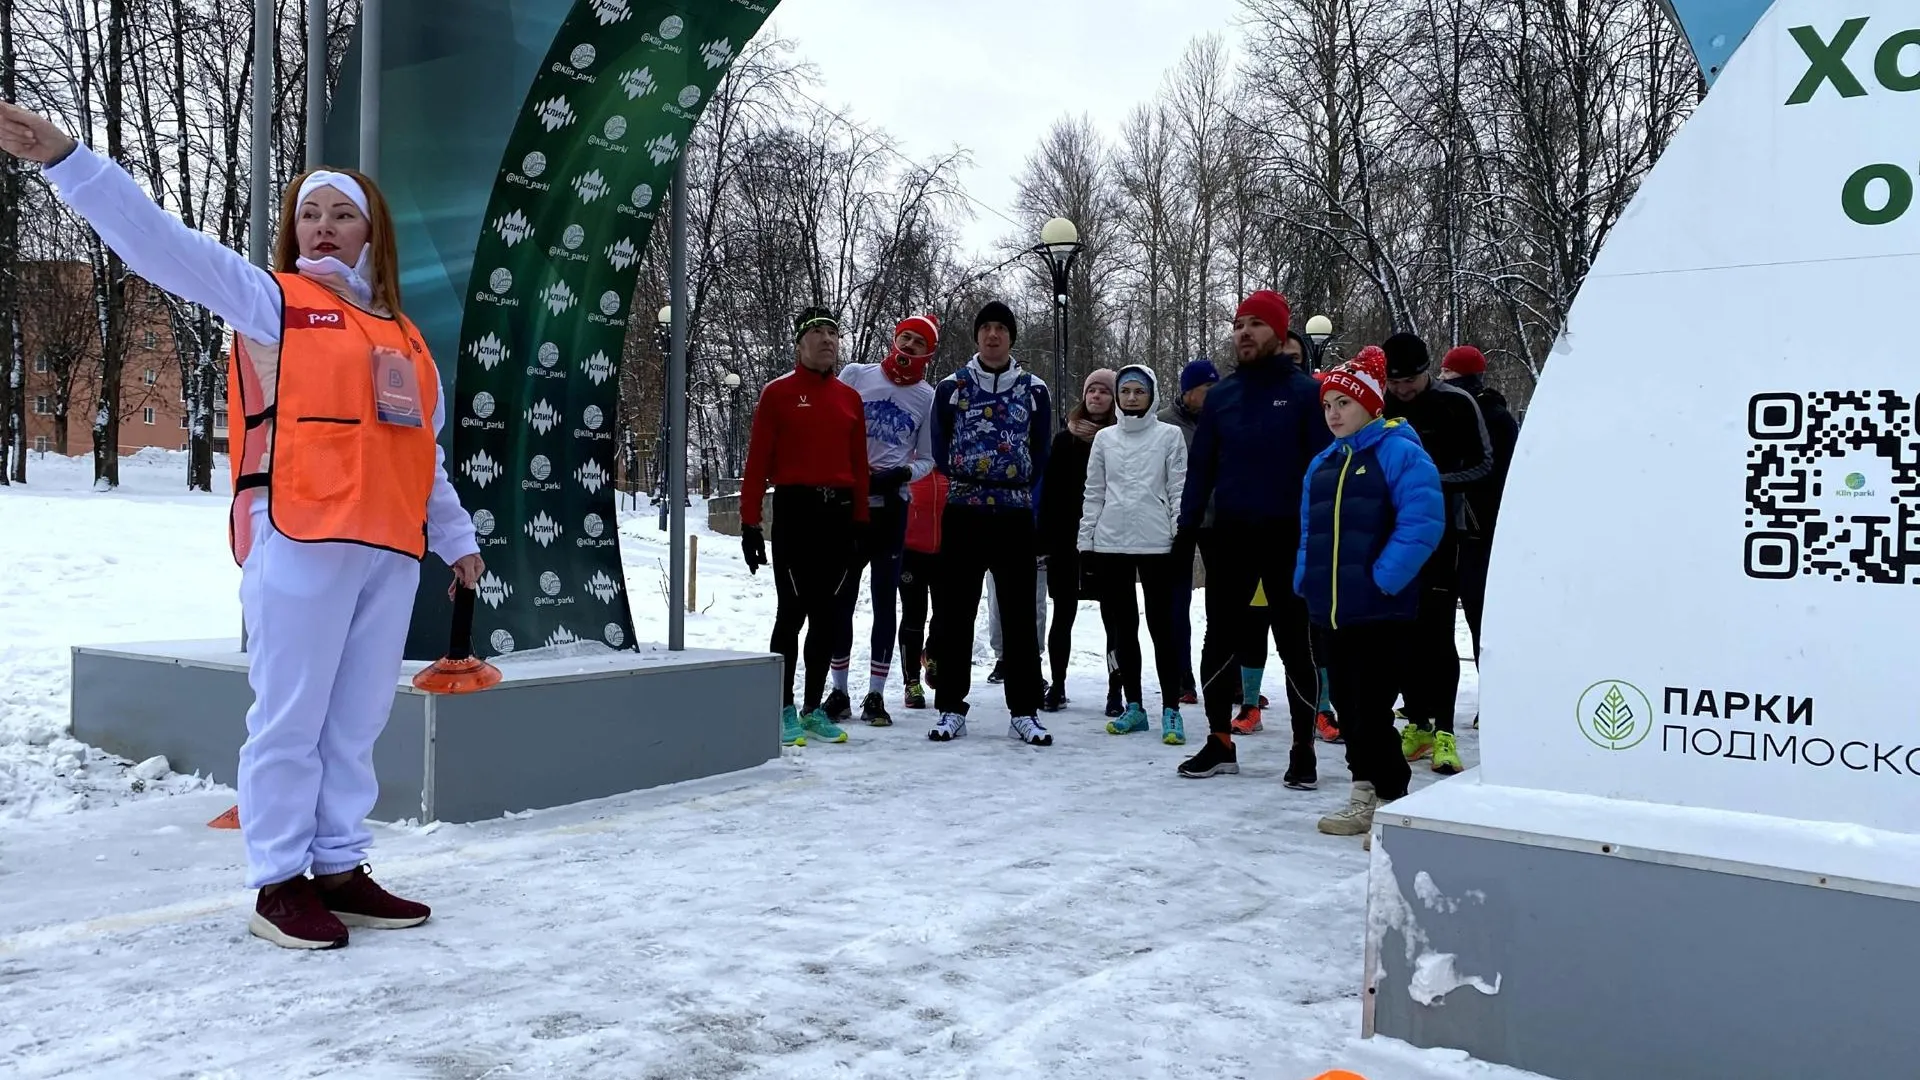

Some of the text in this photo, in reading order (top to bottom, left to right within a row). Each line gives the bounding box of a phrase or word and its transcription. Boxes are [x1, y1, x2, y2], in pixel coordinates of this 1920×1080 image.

[552, 62, 597, 84] @Klin_parki
[544, 108, 567, 121] КЛИН
[506, 173, 550, 192] @Klin_parki
[476, 291, 519, 307] @Klin_parki
[527, 366, 567, 379] @Klin_parki
[462, 417, 505, 430] @Klin_parki
[574, 429, 612, 440] @Klin_parki
[522, 480, 561, 491] @Klin_parki
[1853, 489, 1875, 498] parki
[477, 537, 507, 547] lin_parki
[577, 538, 615, 548] @Klin_parki
[534, 596, 574, 606] @Klin_parki
[1664, 687, 1813, 726] ПАРКИ
